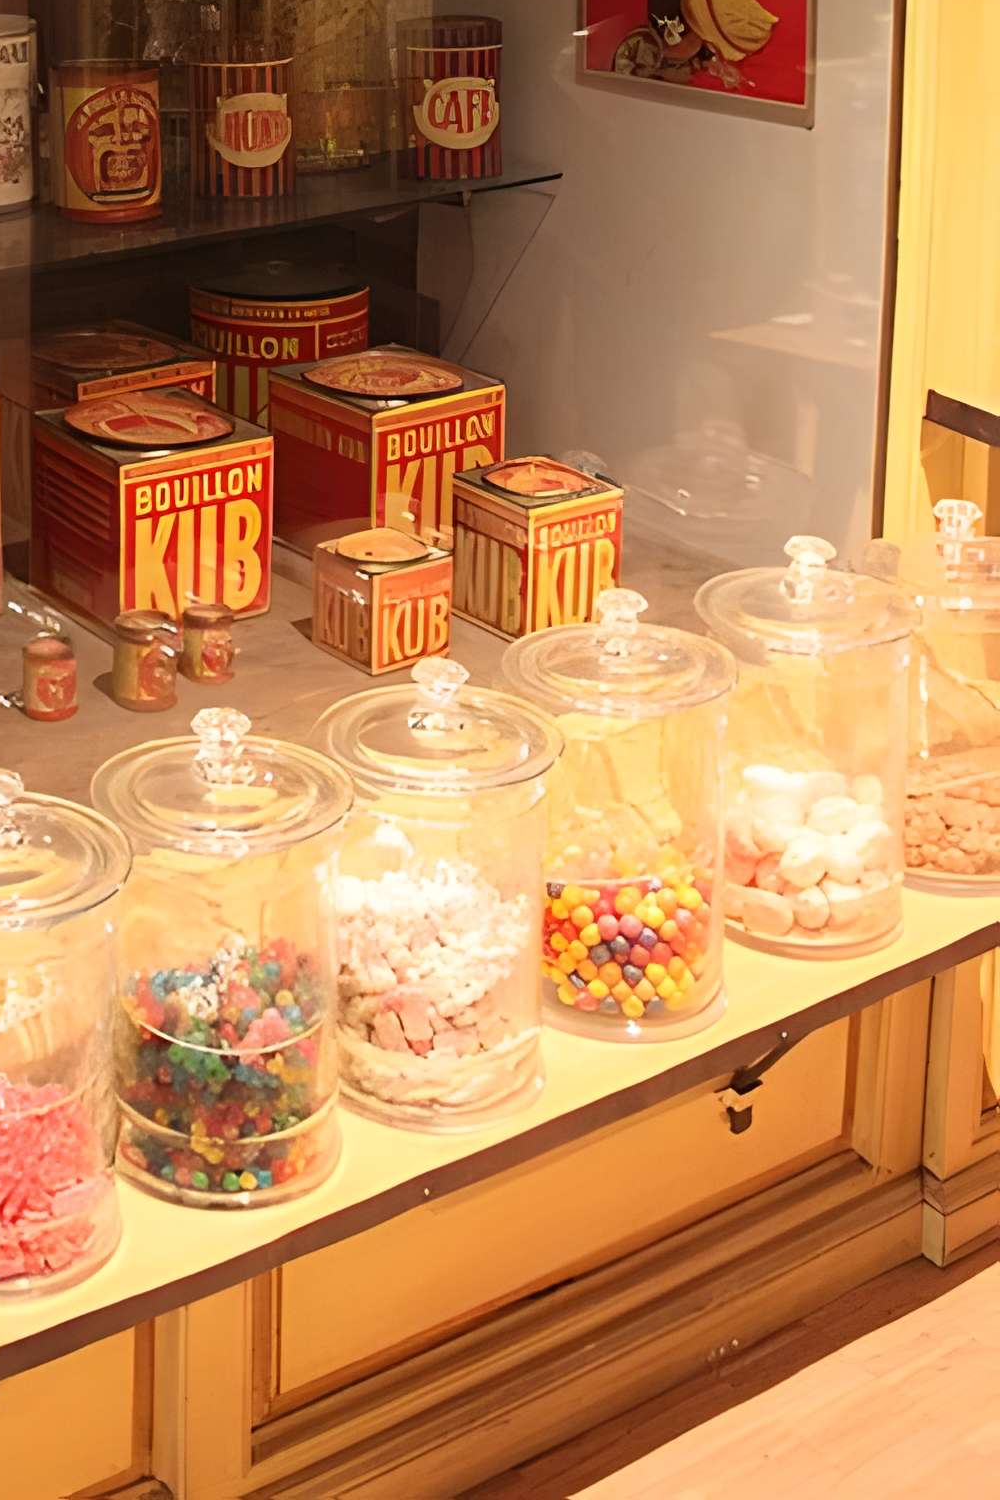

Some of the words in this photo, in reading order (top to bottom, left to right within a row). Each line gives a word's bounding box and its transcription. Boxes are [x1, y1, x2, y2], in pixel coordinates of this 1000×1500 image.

[386, 411, 496, 462] BOUILLON
[134, 462, 263, 516] BOUILLON
[134, 498, 263, 615] KUB
[535, 537, 616, 629] KUB
[382, 593, 449, 665] KUB
